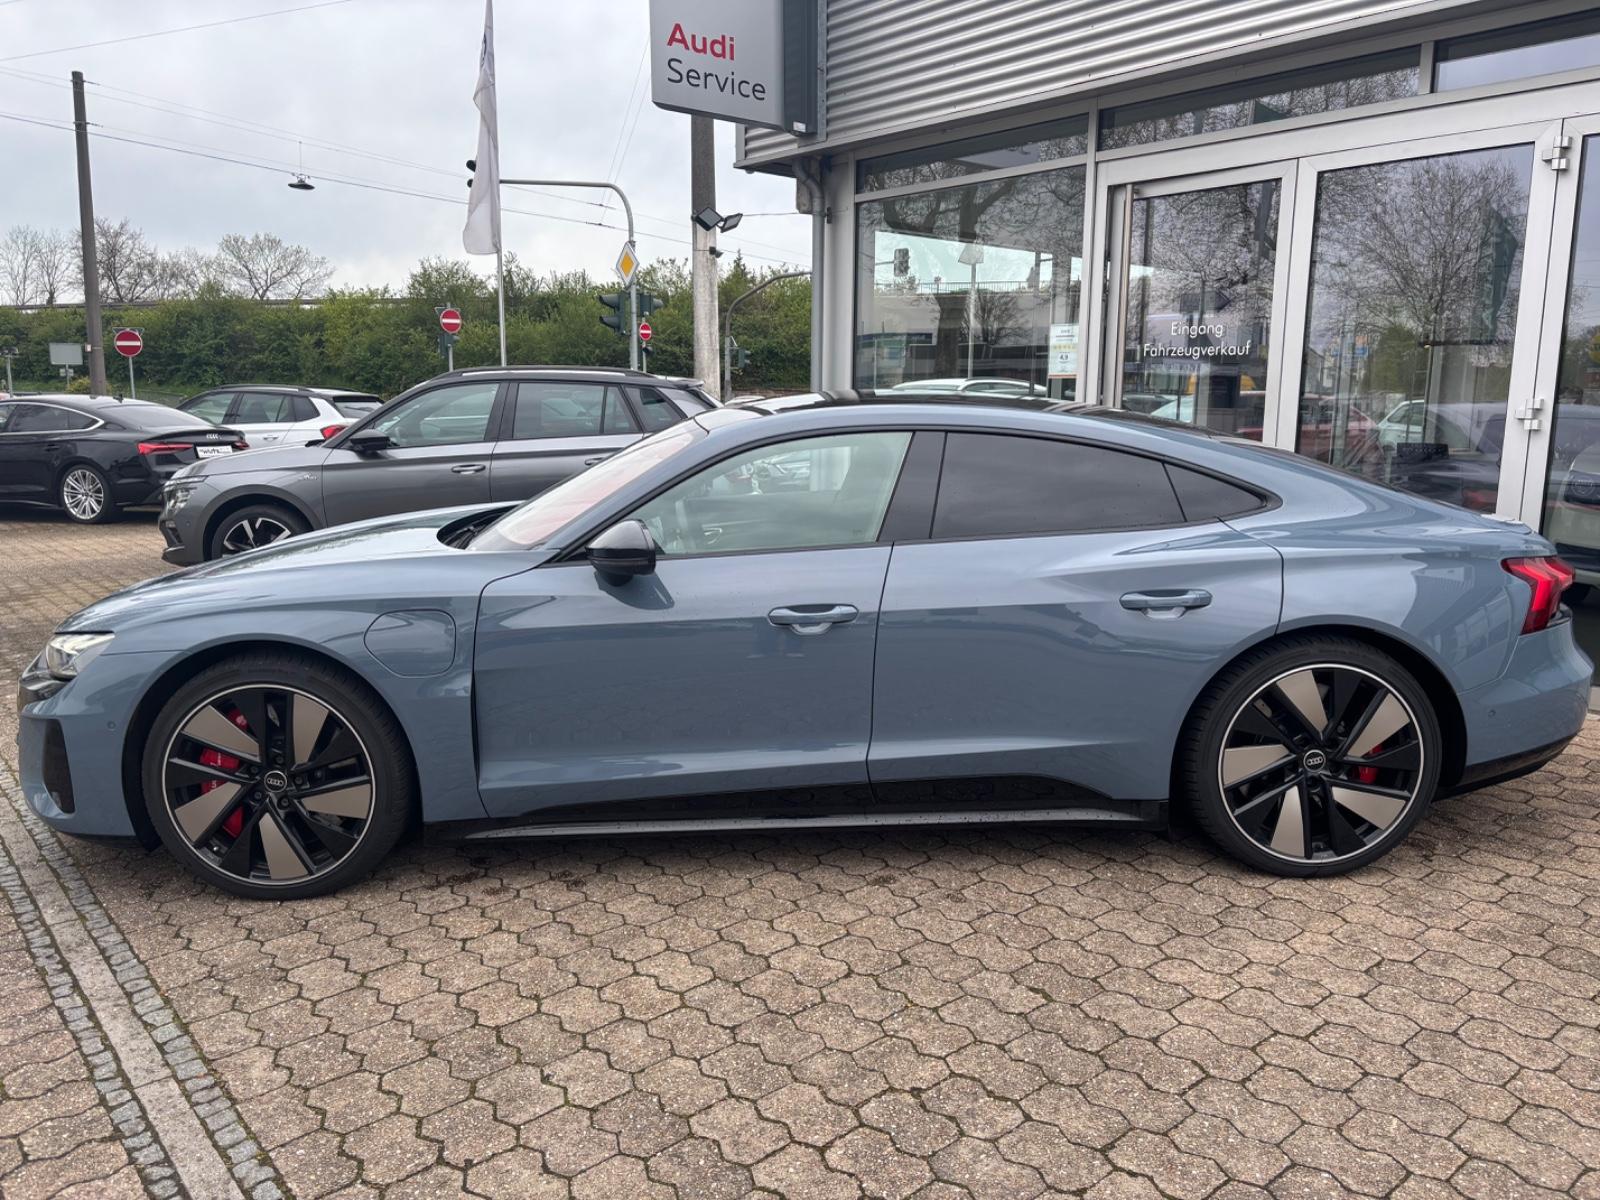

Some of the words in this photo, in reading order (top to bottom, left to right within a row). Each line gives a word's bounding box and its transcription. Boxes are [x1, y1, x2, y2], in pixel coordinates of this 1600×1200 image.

[667, 23, 735, 61] Audi
[667, 57, 766, 101] Service
[1171, 321, 1224, 339] Eingang
[1143, 339, 1251, 359] Fahrzeugverkauf
